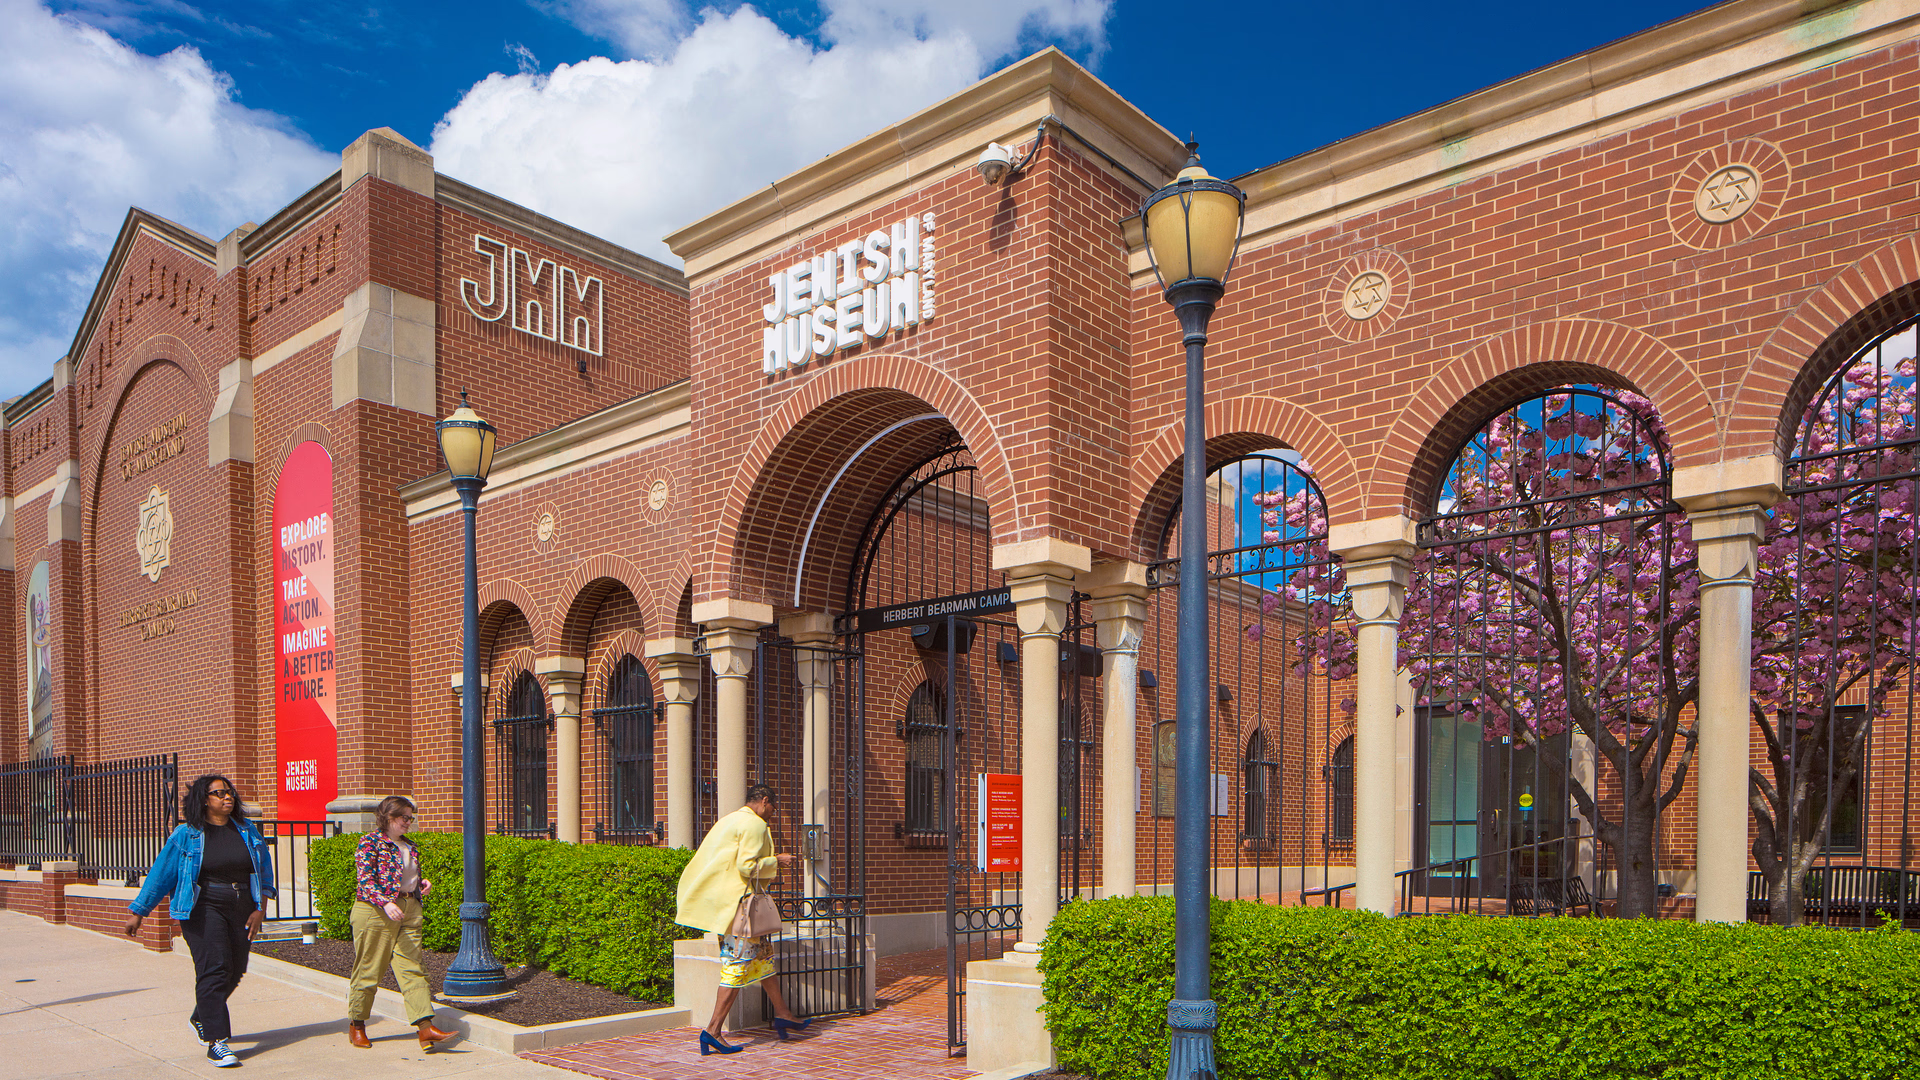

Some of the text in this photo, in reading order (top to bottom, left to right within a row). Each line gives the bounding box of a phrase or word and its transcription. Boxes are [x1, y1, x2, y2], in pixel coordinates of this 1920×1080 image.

[763, 216, 920, 324] JEWISH
[922, 212, 936, 320] OF MARYLAND
[460, 233, 604, 357] JMM
[763, 271, 920, 375] MUSEUM
[120, 412, 188, 467] JEWISH MUSEUM
[122, 435, 185, 481] OF MARYLAND
[281, 512, 327, 548] EXPLORE
[281, 539, 326, 571] HISTORY.
[282, 575, 307, 601] TAKE
[120, 588, 199, 628] HERBERT BEARMAN
[282, 597, 322, 625] ACTION.
[883, 605, 925, 623] HERBERT
[927, 597, 977, 617] BEARMAN
[140, 616, 175, 641] CAMPUS
[282, 625, 327, 655] IMAGINE
[283, 650, 334, 678] A BETTER
[283, 677, 327, 703] FUTURE.
[285, 759, 315, 777] JEWISH
[285, 775, 315, 791] MUSEUM
